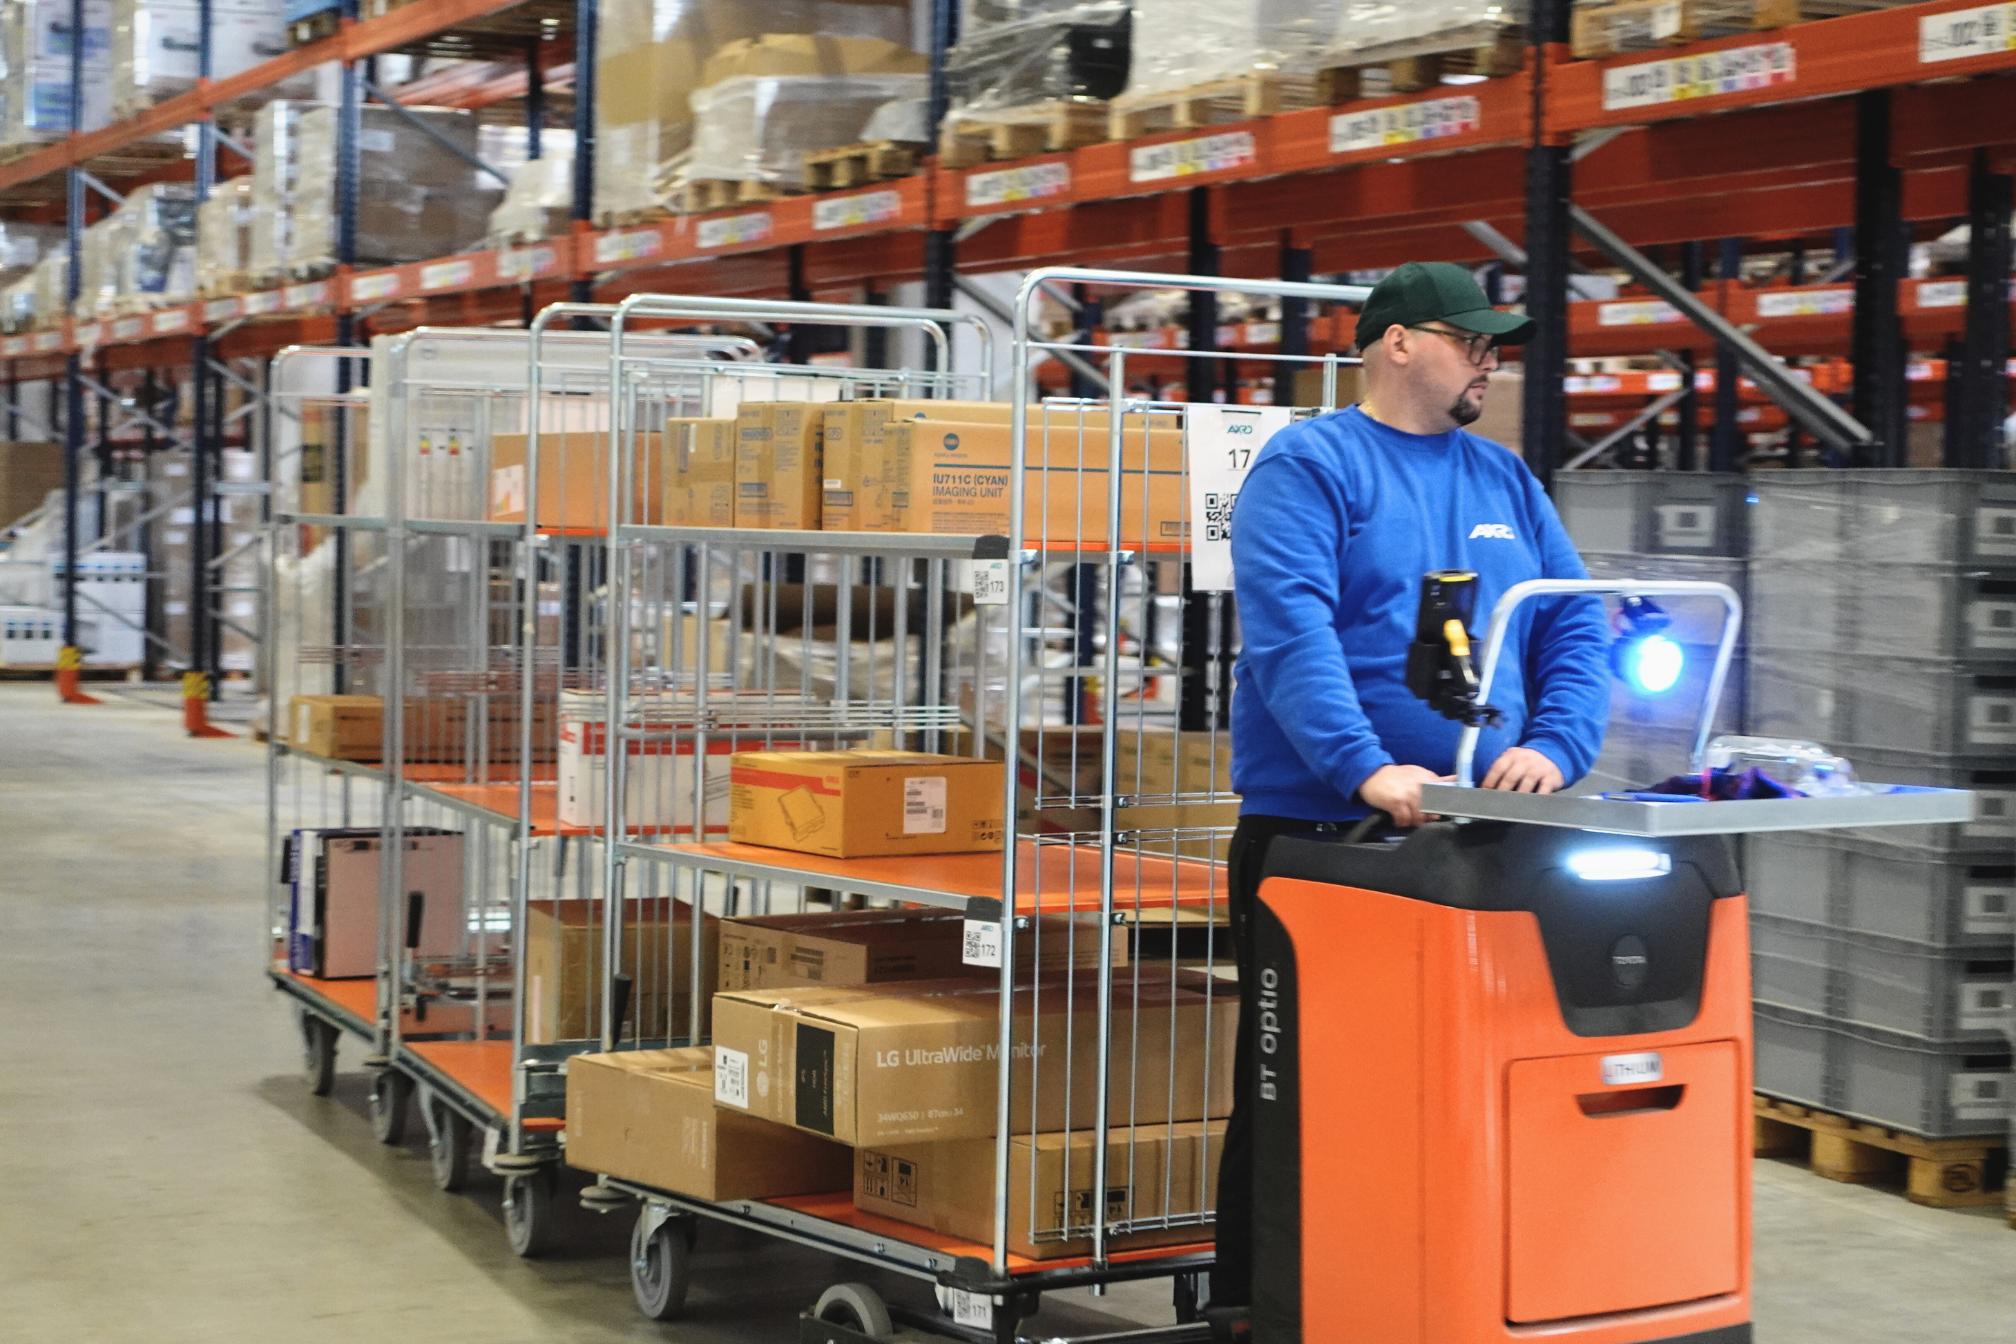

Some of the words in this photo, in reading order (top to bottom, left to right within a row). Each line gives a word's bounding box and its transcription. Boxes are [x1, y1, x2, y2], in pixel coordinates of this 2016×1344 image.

[933, 473, 972, 485] IU711C
[974, 474, 1009, 487] (CYAN)
[932, 486, 977, 497] IMAGING
[980, 487, 1003, 498] UNIT
[990, 580, 1004, 592] 173
[981, 944, 996, 957] 172
[1257, 967, 1282, 1054] optio
[758, 1039, 769, 1067] LG
[876, 1050, 900, 1068] LG
[986, 1042, 1047, 1061] Mnitor
[1260, 1063, 1277, 1101] BT
